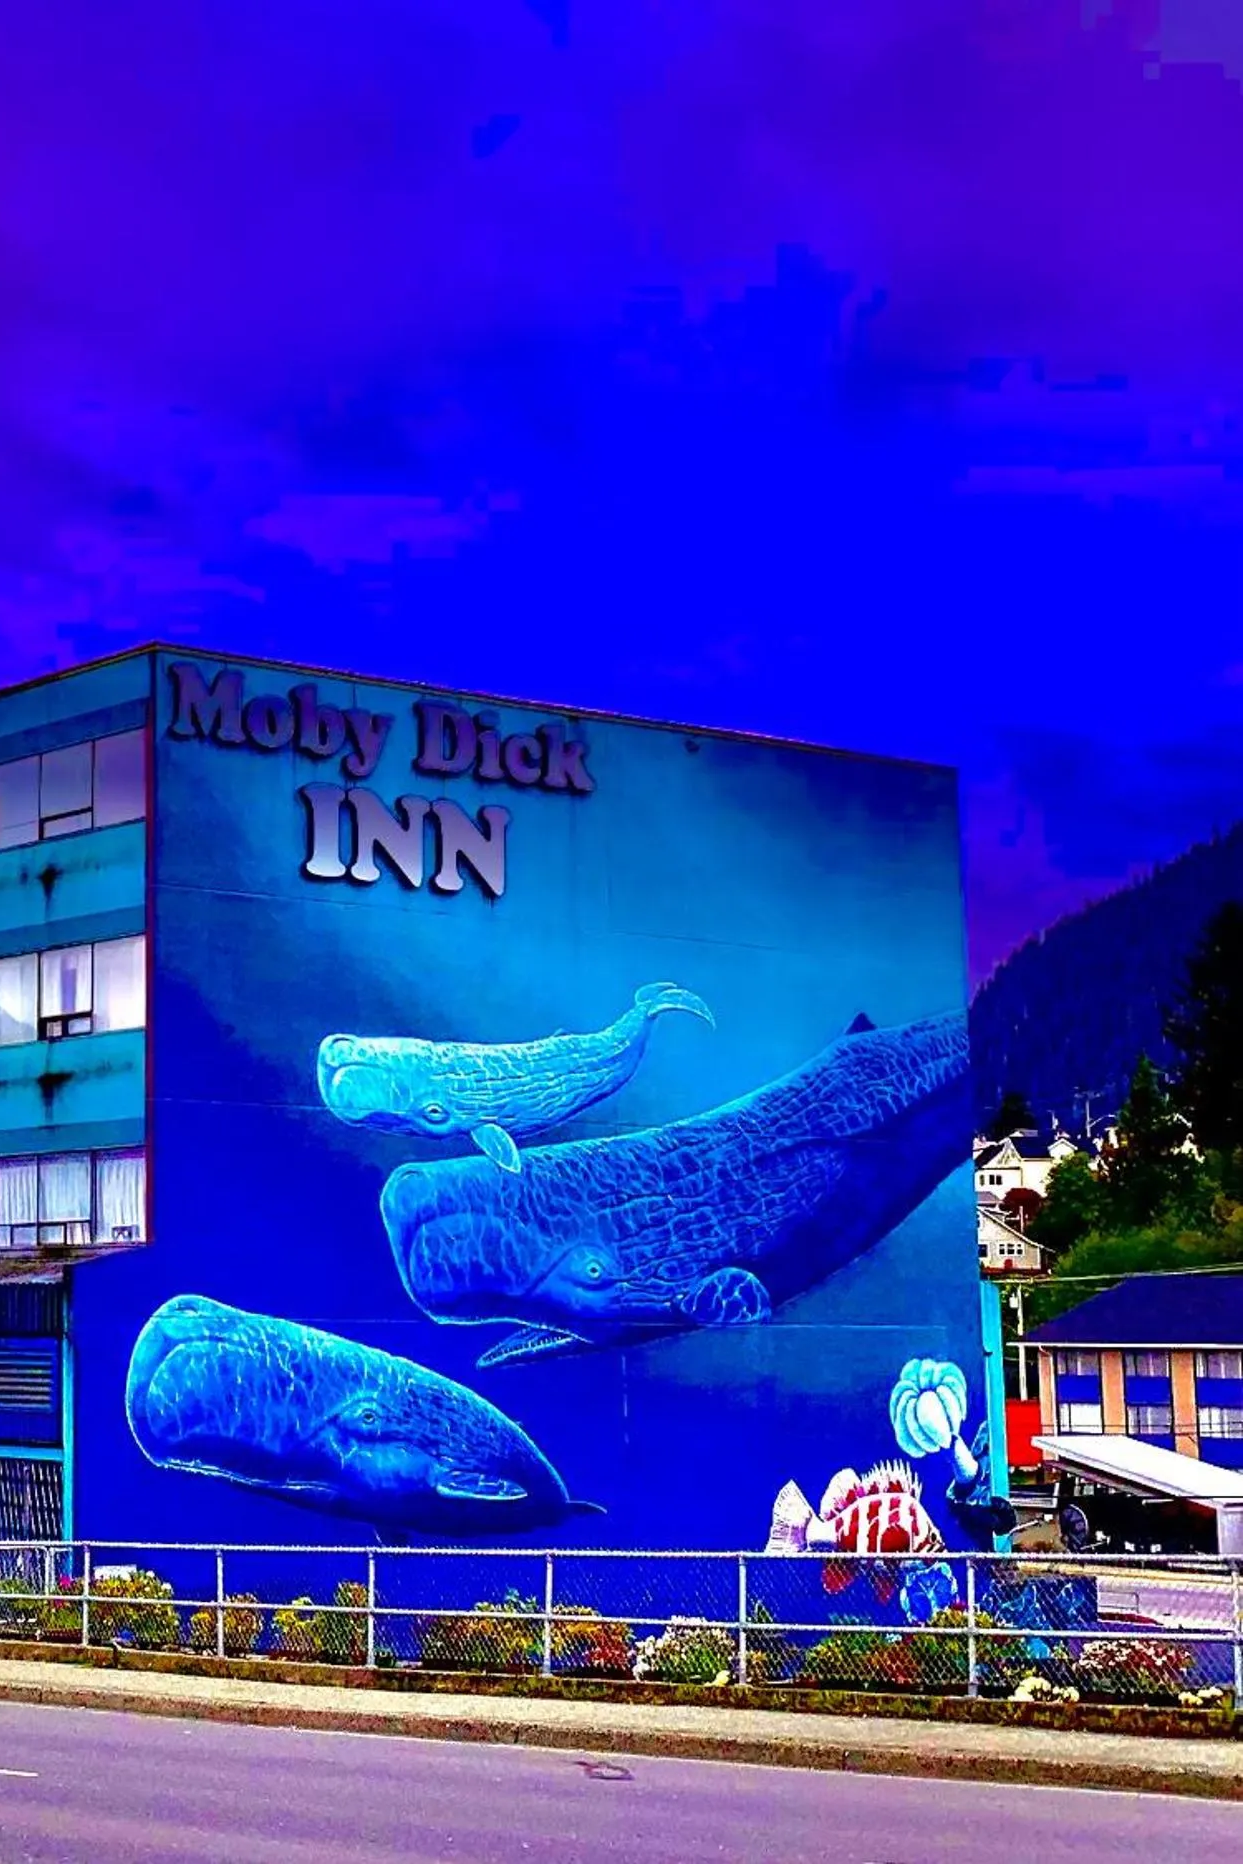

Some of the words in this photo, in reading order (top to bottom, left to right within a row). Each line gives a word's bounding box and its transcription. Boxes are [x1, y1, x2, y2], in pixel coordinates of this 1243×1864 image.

[168, 662, 393, 777] Moby
[414, 699, 595, 793] Dick
[299, 782, 511, 897] INN
